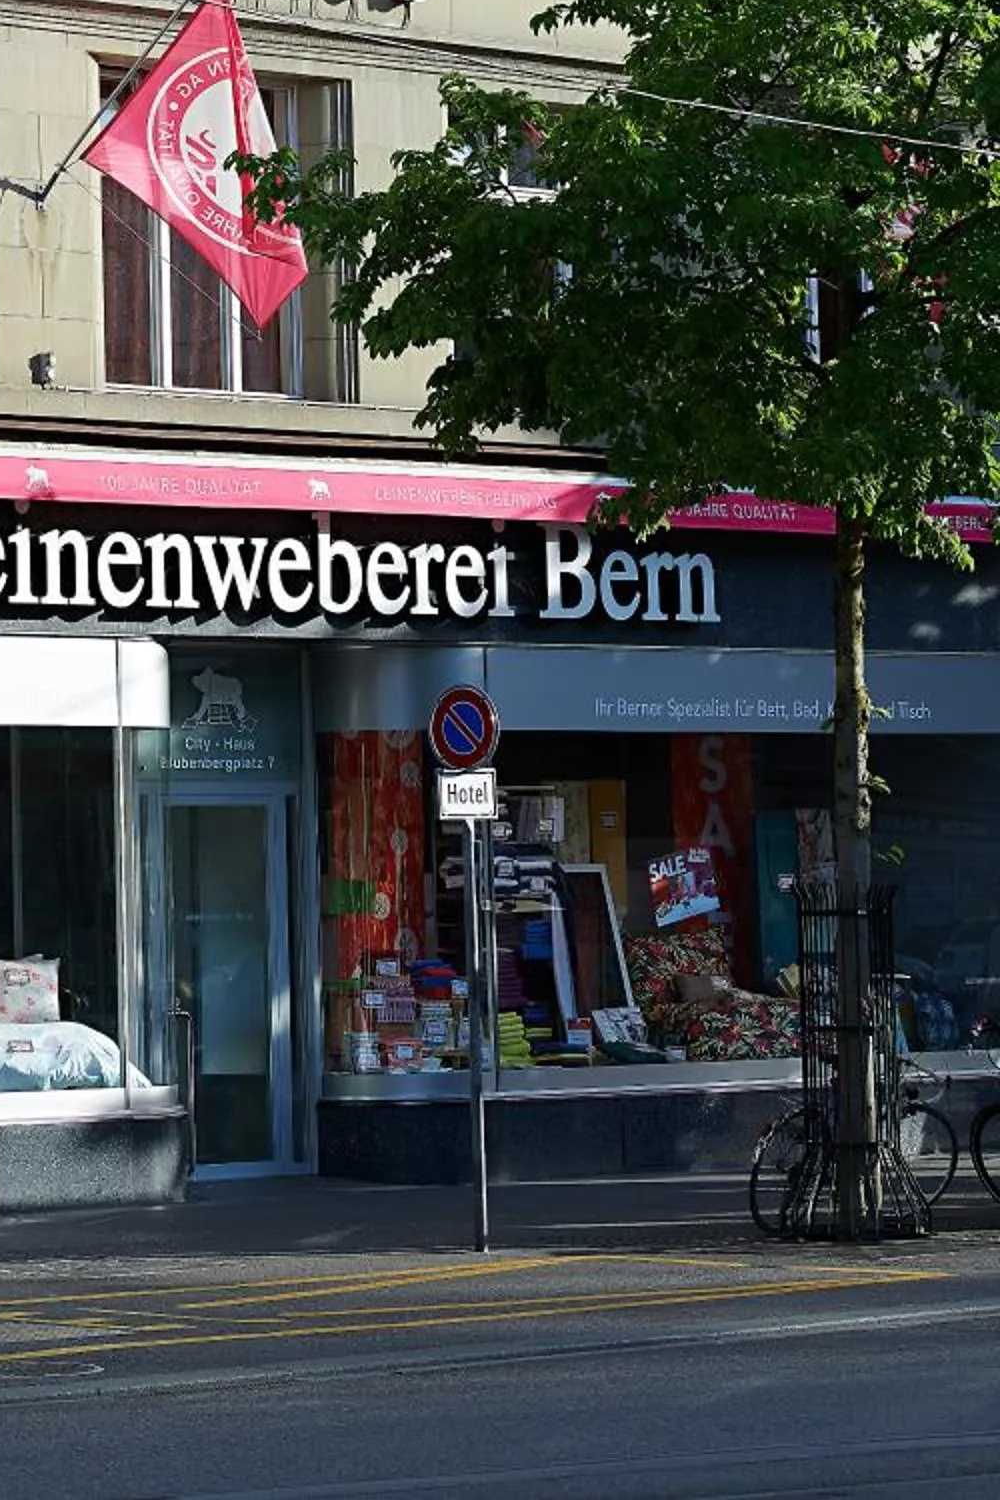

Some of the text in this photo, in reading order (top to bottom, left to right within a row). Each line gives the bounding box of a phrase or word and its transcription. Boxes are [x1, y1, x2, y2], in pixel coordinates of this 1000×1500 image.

[686, 502, 727, 518] JAHRE
[732, 503, 798, 522] QUALITÄT
[535, 521, 721, 624] Bern
[595, 697, 614, 717] Ihr
[897, 700, 932, 719] Tisch
[185, 736, 211, 752] City
[446, 781, 489, 805] Hotel
[648, 855, 687, 883] SALE
